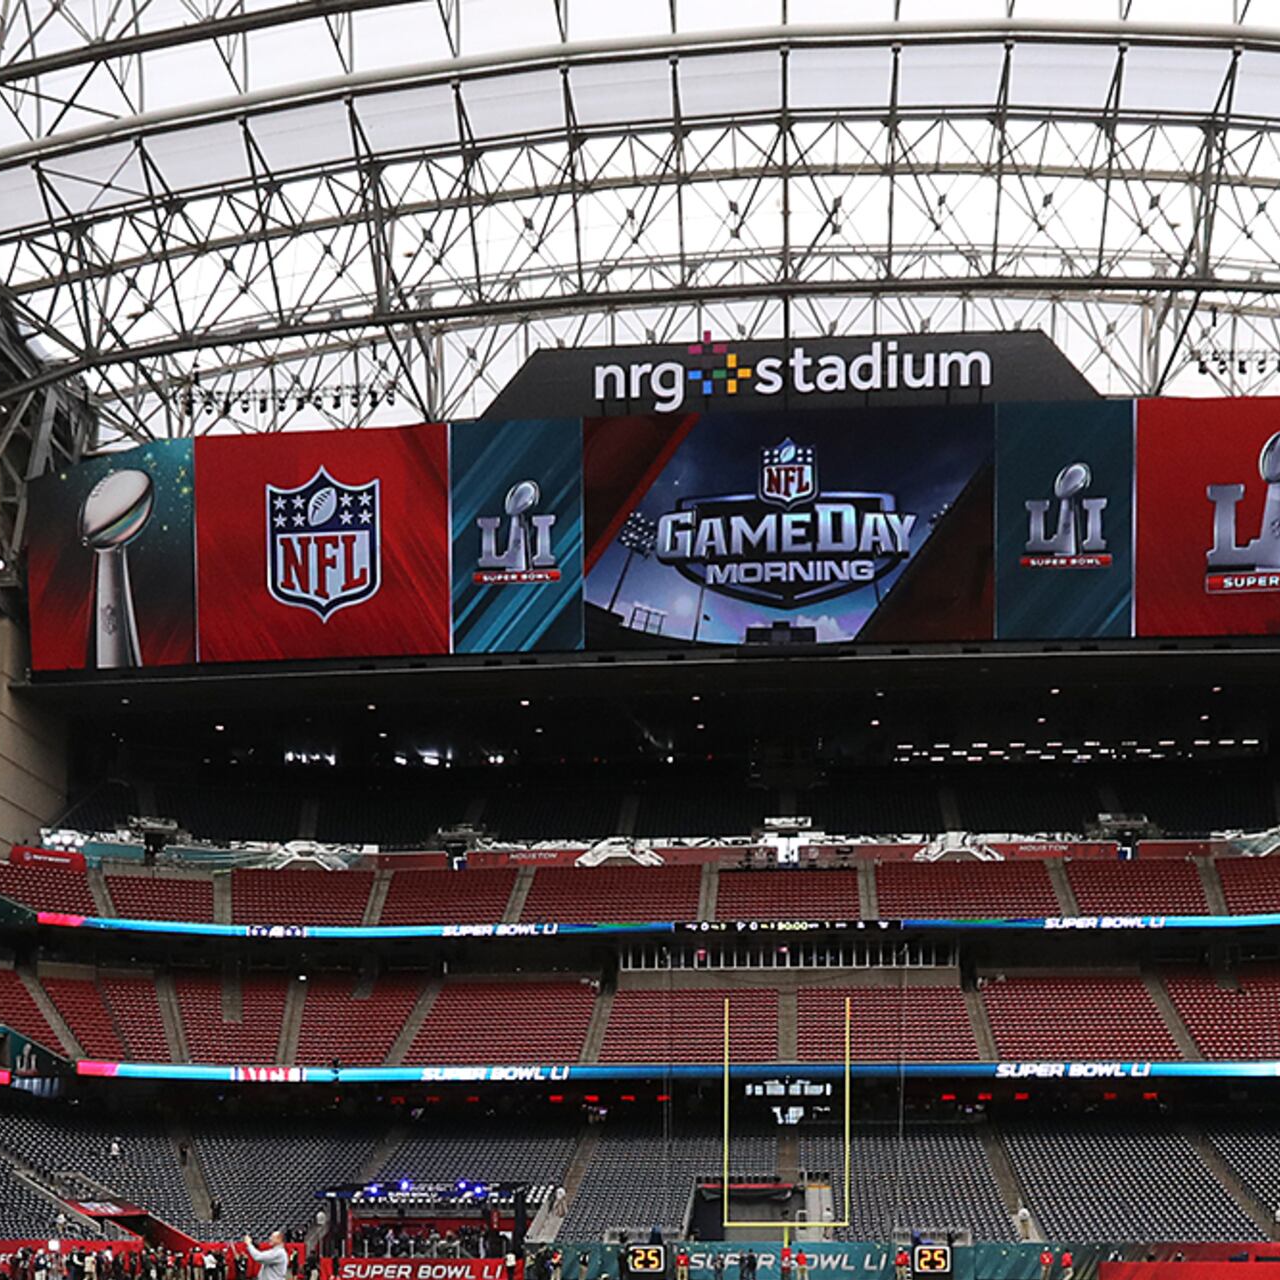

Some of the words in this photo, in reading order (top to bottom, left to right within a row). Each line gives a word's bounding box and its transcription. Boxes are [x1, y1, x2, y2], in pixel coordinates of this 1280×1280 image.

[595, 361, 685, 413] nrg
[754, 341, 991, 395] stadium
[766, 466, 810, 494] NFL
[280, 533, 368, 599] NFL
[1030, 558, 1067, 567] SUPER
[1070, 557, 1101, 566] BOWL
[482, 574, 518, 583] SUPER
[521, 572, 551, 581] BOWL
[706, 560, 875, 584] MORNING
[1223, 575, 1280, 589] SUPER
[442, 925, 494, 937] SUPER
[496, 924, 540, 936] BOWL
[543, 924, 559, 934] LI
[1043, 917, 1099, 929] SUPER
[1101, 916, 1145, 928] BOWL
[1149, 916, 1166, 928] LI
[421, 1068, 487, 1081] SUPER
[490, 1067, 545, 1081] BOWL
[551, 1066, 570, 1080] LI
[995, 1063, 1065, 1077] SUPER
[1070, 1063, 1127, 1077] BOWL
[1131, 1063, 1151, 1076] LI
[634, 1249, 660, 1269] 25
[689, 1253, 775, 1270] SUPR
[864, 1253, 887, 1270] LI
[919, 1249, 945, 1269] 25
[342, 1263, 411, 1279] SUPER
[417, 1264, 476, 1279] BOWL
[483, 1264, 503, 1279] LI
